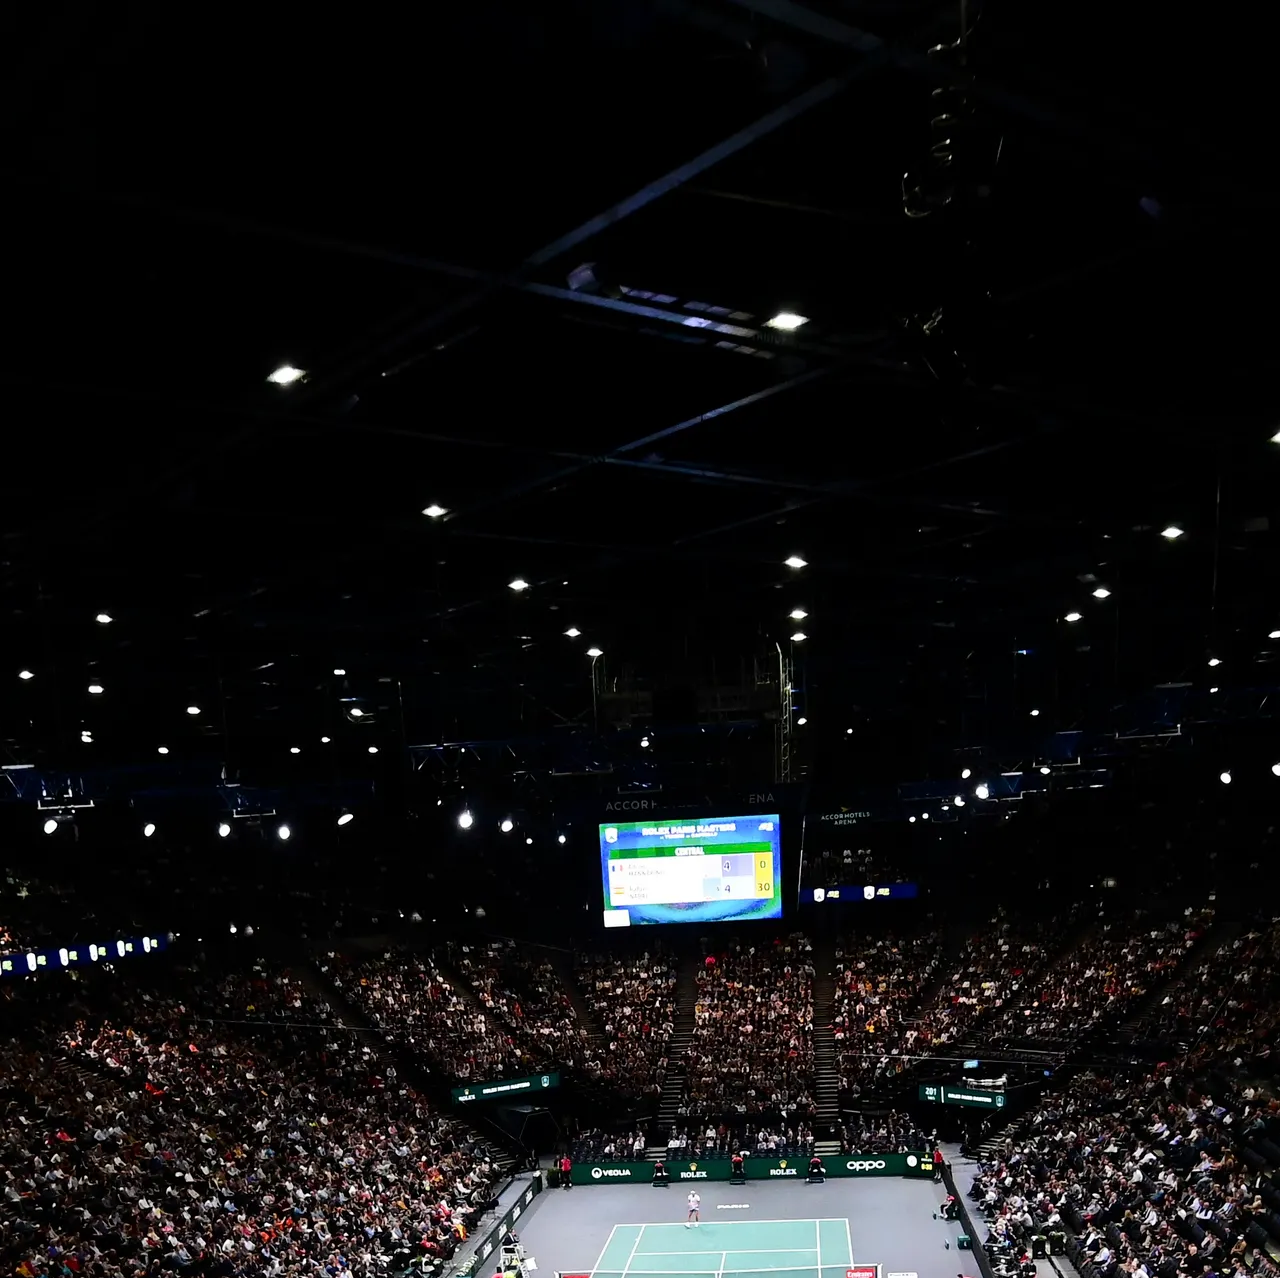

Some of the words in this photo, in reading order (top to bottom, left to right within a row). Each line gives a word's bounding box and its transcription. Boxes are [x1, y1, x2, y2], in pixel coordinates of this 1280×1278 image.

[833, 818, 857, 826] ARENA
[759, 860, 766, 869] 0
[757, 882, 770, 891] 30
[924, 1087, 937, 1096] 201
[846, 1160, 886, 1172] oppo
[602, 1169, 631, 1177] VEOLIA
[680, 1171, 707, 1179] ROLEX
[769, 1168, 796, 1176] ROLEX
